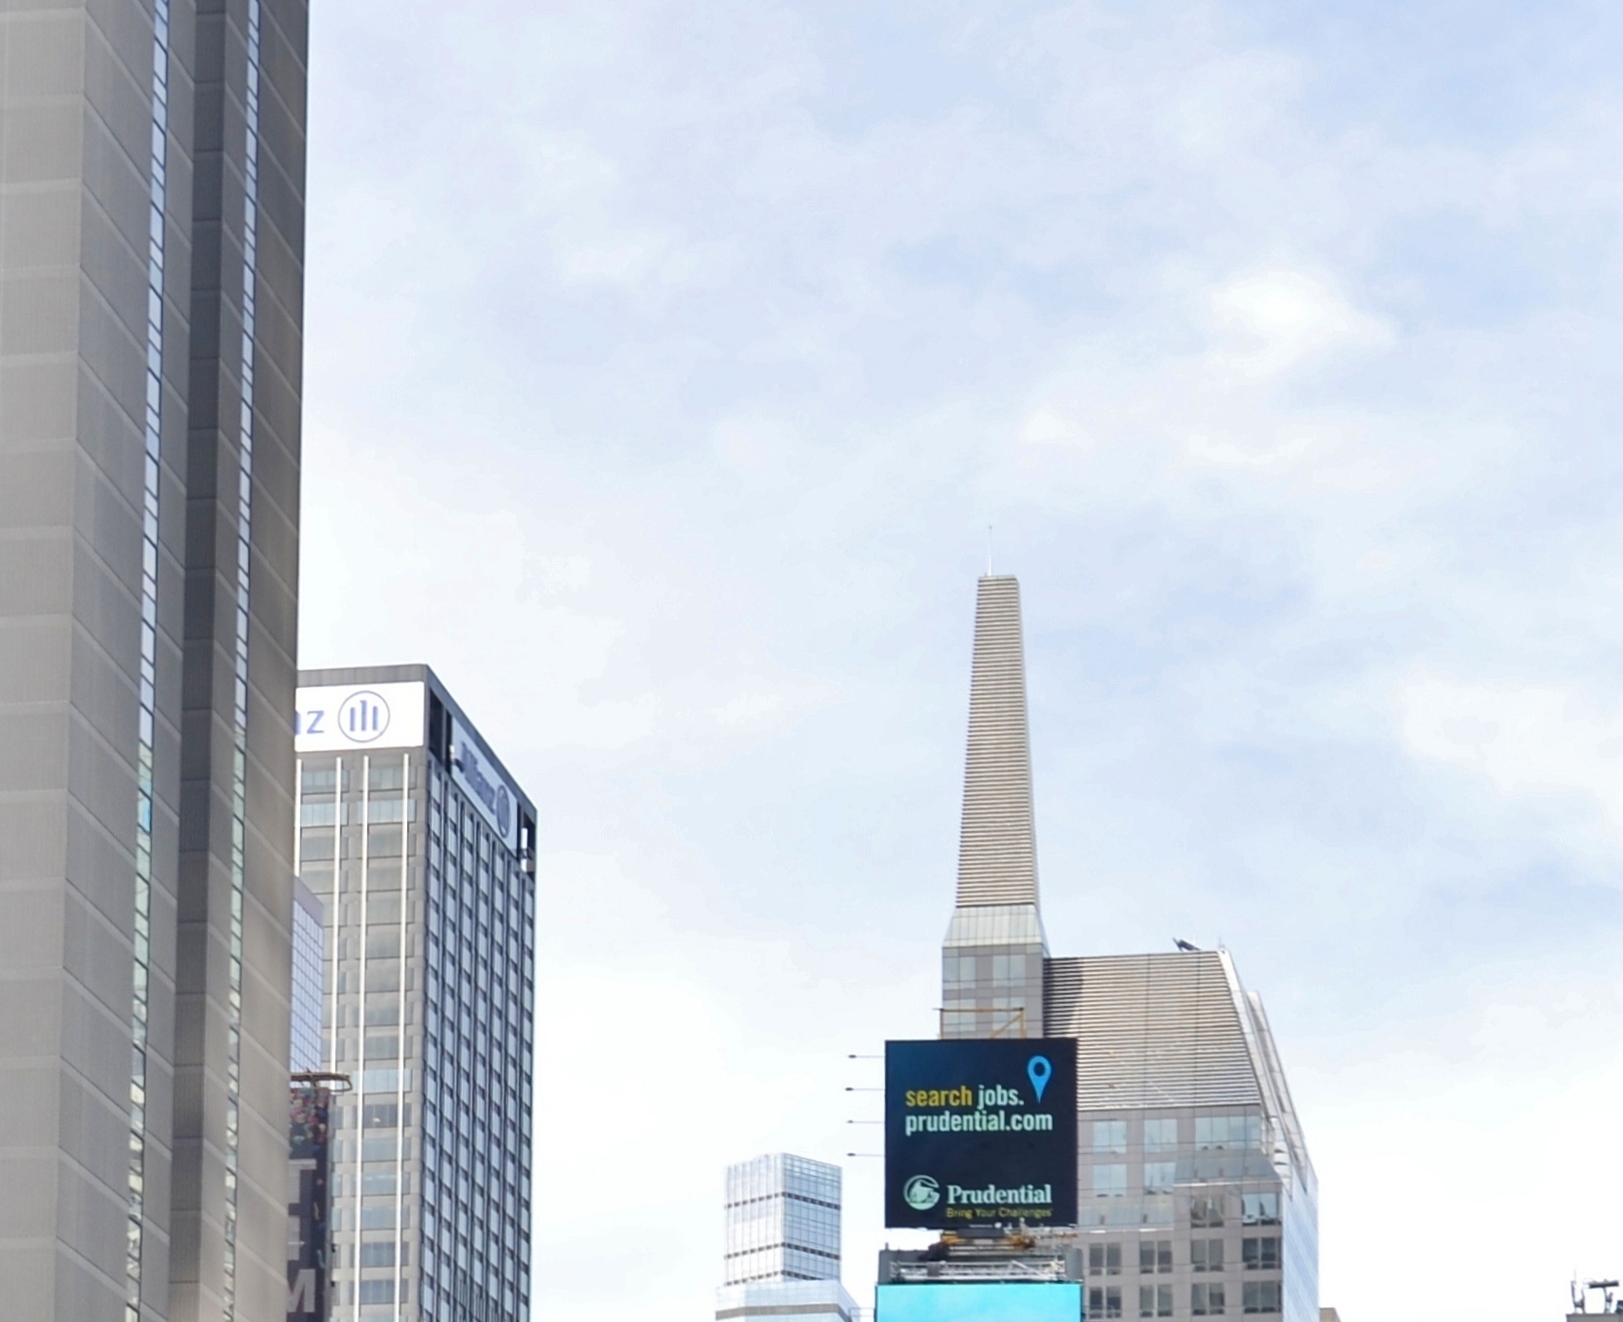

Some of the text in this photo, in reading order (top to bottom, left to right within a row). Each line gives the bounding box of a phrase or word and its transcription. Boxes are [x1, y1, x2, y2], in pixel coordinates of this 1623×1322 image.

[905, 1084, 1025, 1109] search jobs.
[905, 1110, 1053, 1136] prudential.com
[946, 1184, 1052, 1204] Prudential
[946, 1208, 973, 1219] Bring
[976, 1208, 996, 1217] Your
